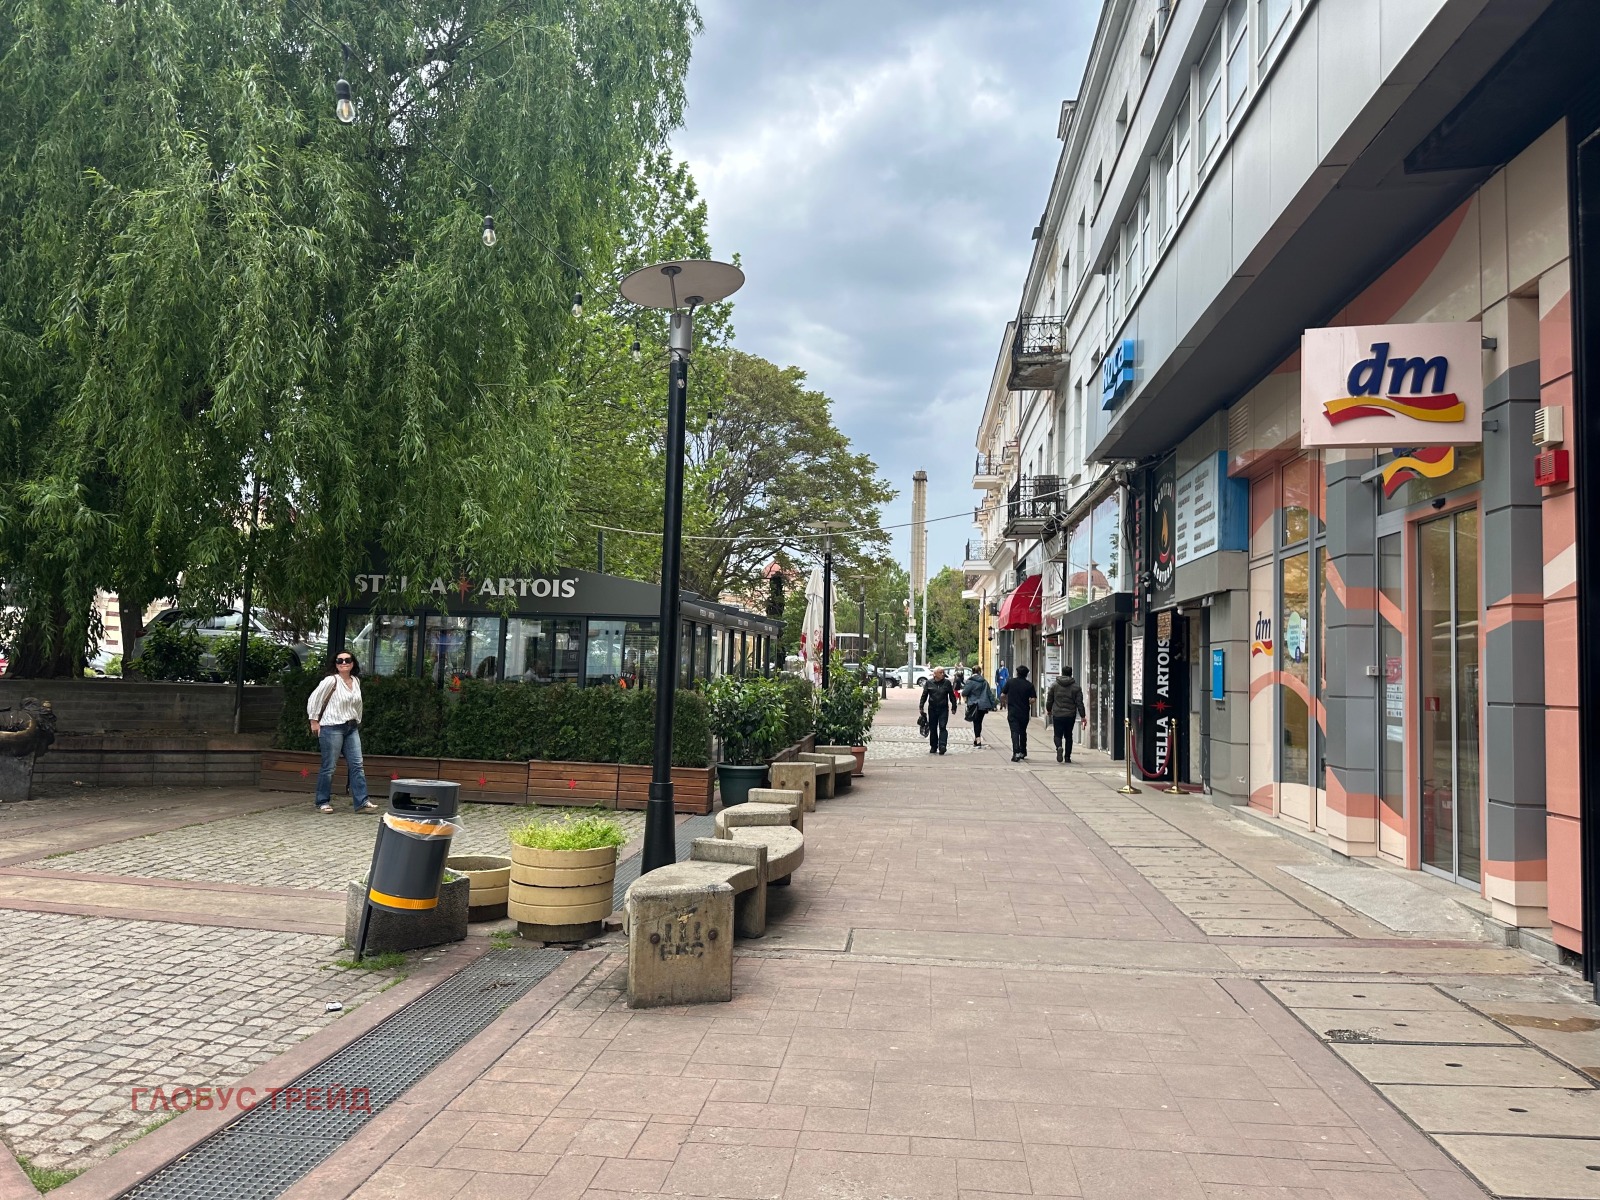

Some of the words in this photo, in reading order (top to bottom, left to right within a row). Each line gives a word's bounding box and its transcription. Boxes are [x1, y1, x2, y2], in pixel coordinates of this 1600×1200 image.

[1347, 342, 1448, 396] dm
[354, 573, 447, 595] STLA
[478, 577, 576, 598] ARTOIS
[1255, 611, 1271, 640] dm
[1156, 638, 1170, 698] ARTOIS
